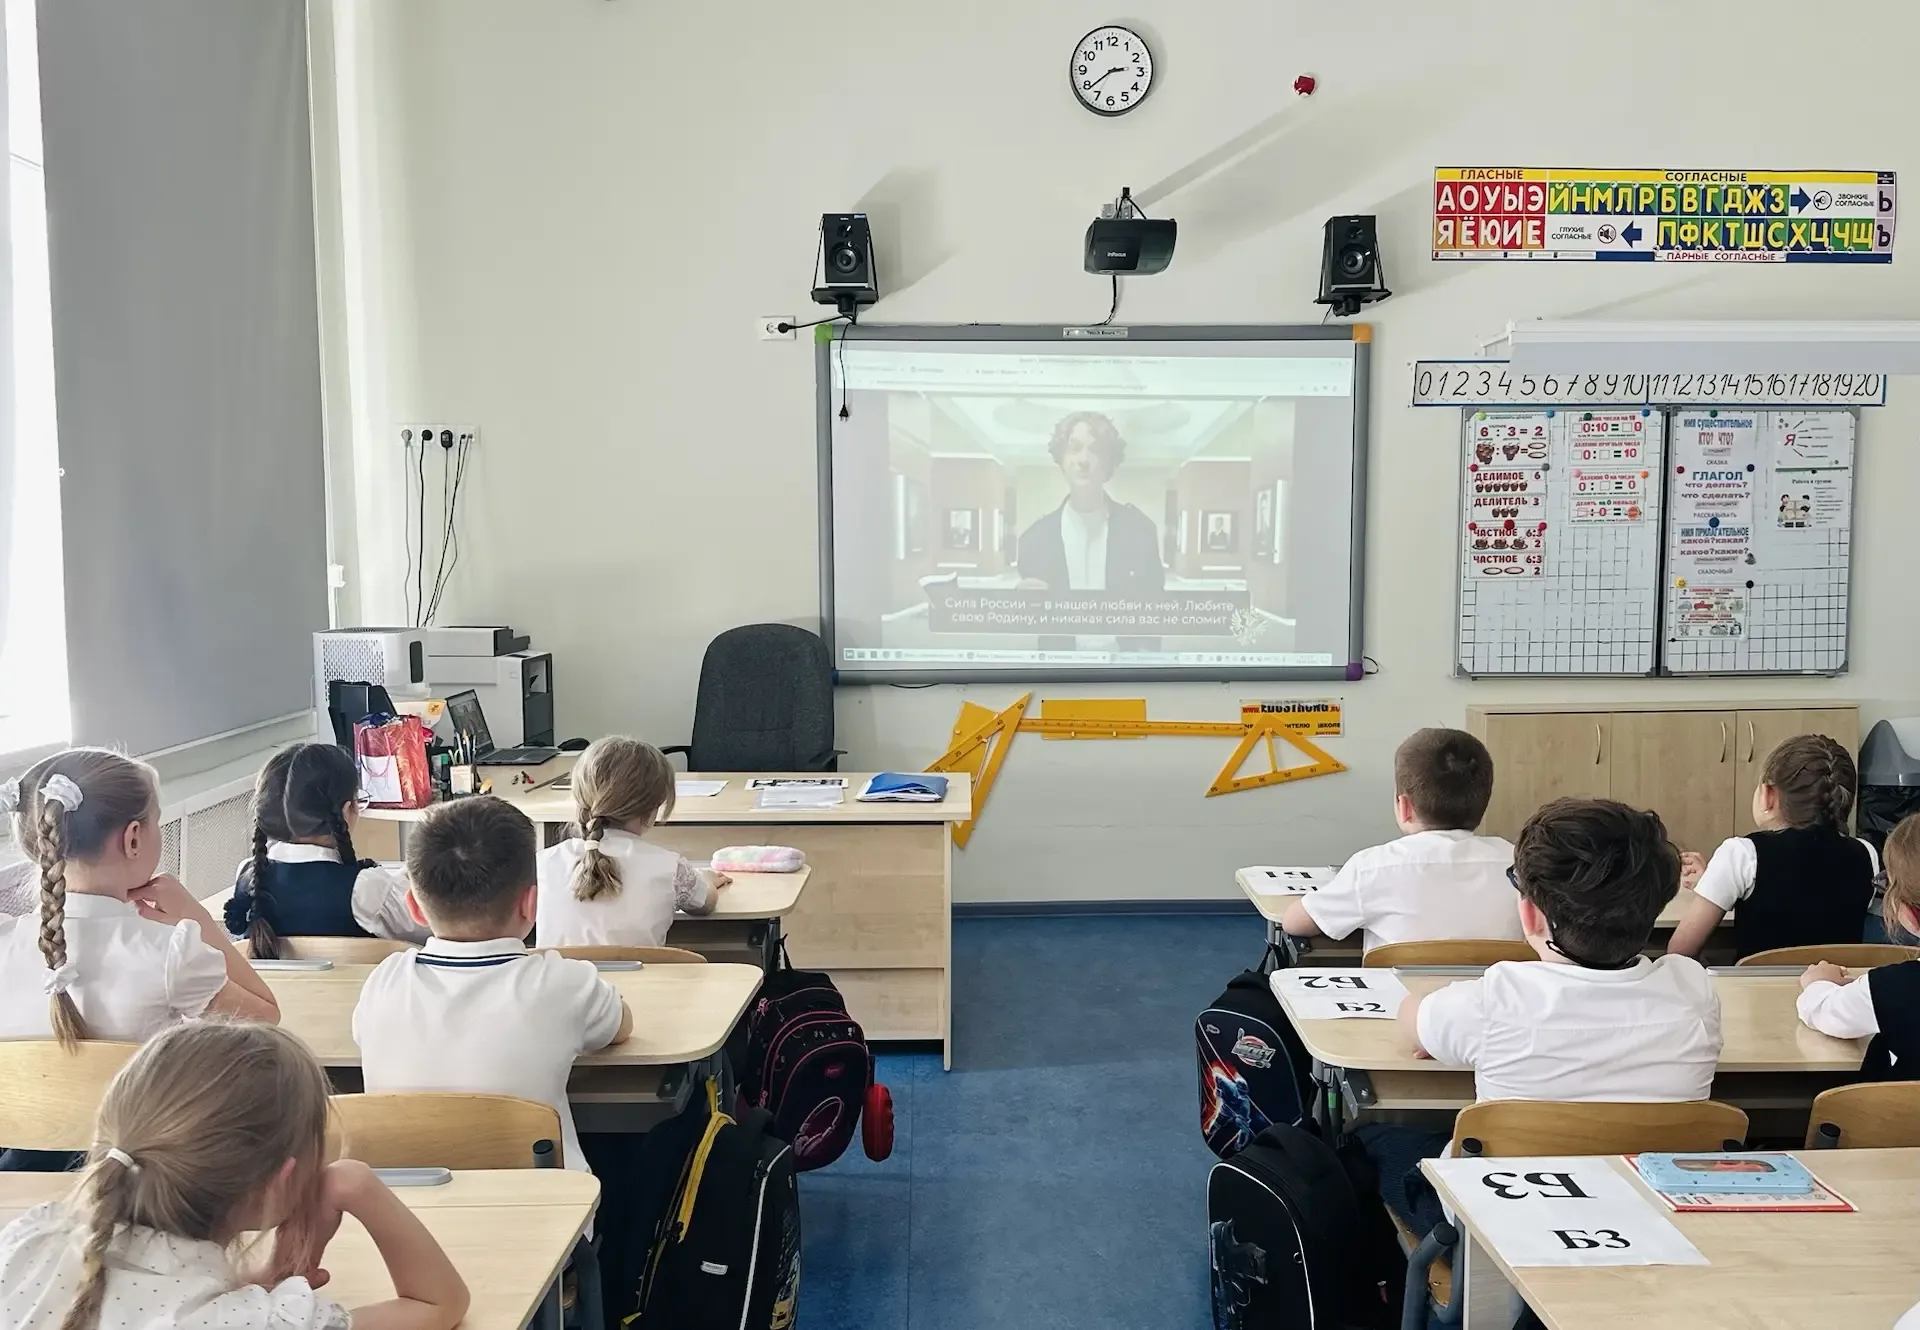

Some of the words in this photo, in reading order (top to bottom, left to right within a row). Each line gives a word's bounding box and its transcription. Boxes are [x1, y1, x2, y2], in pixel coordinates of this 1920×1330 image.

[1094, 40, 1103, 51] 11
[1106, 36, 1119, 47] 12
[1124, 41, 1129, 51] 1
[1083, 51, 1096, 61] 10
[1132, 52, 1140, 63] 2
[1078, 65, 1087, 75] 9
[1136, 67, 1145, 77] 3
[1083, 80, 1091, 90] 8
[1130, 81, 1139, 92] 4
[1093, 90, 1102, 101] 7
[1121, 91, 1129, 102] 5
[1106, 96, 1115, 107] 6
[1461, 170, 1524, 180] ГЛАСНЫЕ
[1665, 172, 1747, 182] СОГЛАСНЫЕ
[1879, 191, 1892, 212] Ь
[1667, 252, 1709, 260] ПАРНЫЕ
[1714, 252, 1775, 260] СОГЛАСНЫЕ
[1419, 370, 1432, 396] 0
[1439, 371, 1449, 396] 1
[1452, 370, 1470, 396] 2
[1475, 370, 1491, 396] 3
[1498, 370, 1513, 396] 4
[1520, 374, 1536, 396] 5
[1543, 374, 1559, 396] 6
[1584, 374, 1600, 396] 8
[1623, 374, 1645, 396] 10
[1652, 374, 1669, 396] 11
[1672, 374, 1694, 396] 12
[1696, 374, 1717, 396] 13
[1720, 374, 1740, 396] 14
[1744, 374, 1763, 396] 15
[1767, 374, 1786, 396] 16
[1811, 374, 1831, 396] 18
[1852, 374, 1880, 396] 20
[1480, 426, 1489, 437] 6
[1507, 426, 1516, 437] 3
[1534, 426, 1543, 436] 2
[1634, 421, 1642, 432] 0
[1784, 434, 1796, 446] Я
[1624, 448, 1637, 458] 10
[1475, 472, 1524, 482] ДЕЛИМОЕ
[1534, 471, 1541, 480] 6
[1692, 471, 1743, 481] ГЛАГОЛ
[1579, 482, 1586, 491] 0
[1628, 480, 1636, 489] 0
[1705, 481, 1748, 489] делать?
[1702, 491, 1750, 500] сделать?
[1474, 497, 1528, 507] ДЕЛИТЕЛЬ
[1532, 497, 1540, 506] 3
[1474, 529, 1518, 537] ЧАСТНОЕ
[1534, 540, 1541, 548] 2
[1474, 555, 1518, 563] ЧАСТНОЕ
[1526, 555, 1542, 564] 6:3
[1534, 567, 1541, 575] 2
[945, 598, 977, 609] Сила
[980, 598, 1026, 610] России
[1044, 602, 1052, 610] в
[1055, 600, 1097, 611] нашей
[1100, 600, 1142, 611] любви
[1144, 602, 1152, 610] к
[1155, 601, 1182, 611] ней.
[1184, 600, 1234, 611] Любите
[952, 613, 984, 623] свою
[987, 612, 1037, 625] Родину,
[1040, 615, 1048, 623] и
[1051, 614, 1102, 624] никакая
[1106, 615, 1135, 624] сила
[1139, 615, 1160, 624] вас
[1163, 615, 1179, 624] не
[1181, 615, 1227, 624] сломит
[1334, 1002, 1386, 1012] Б2
